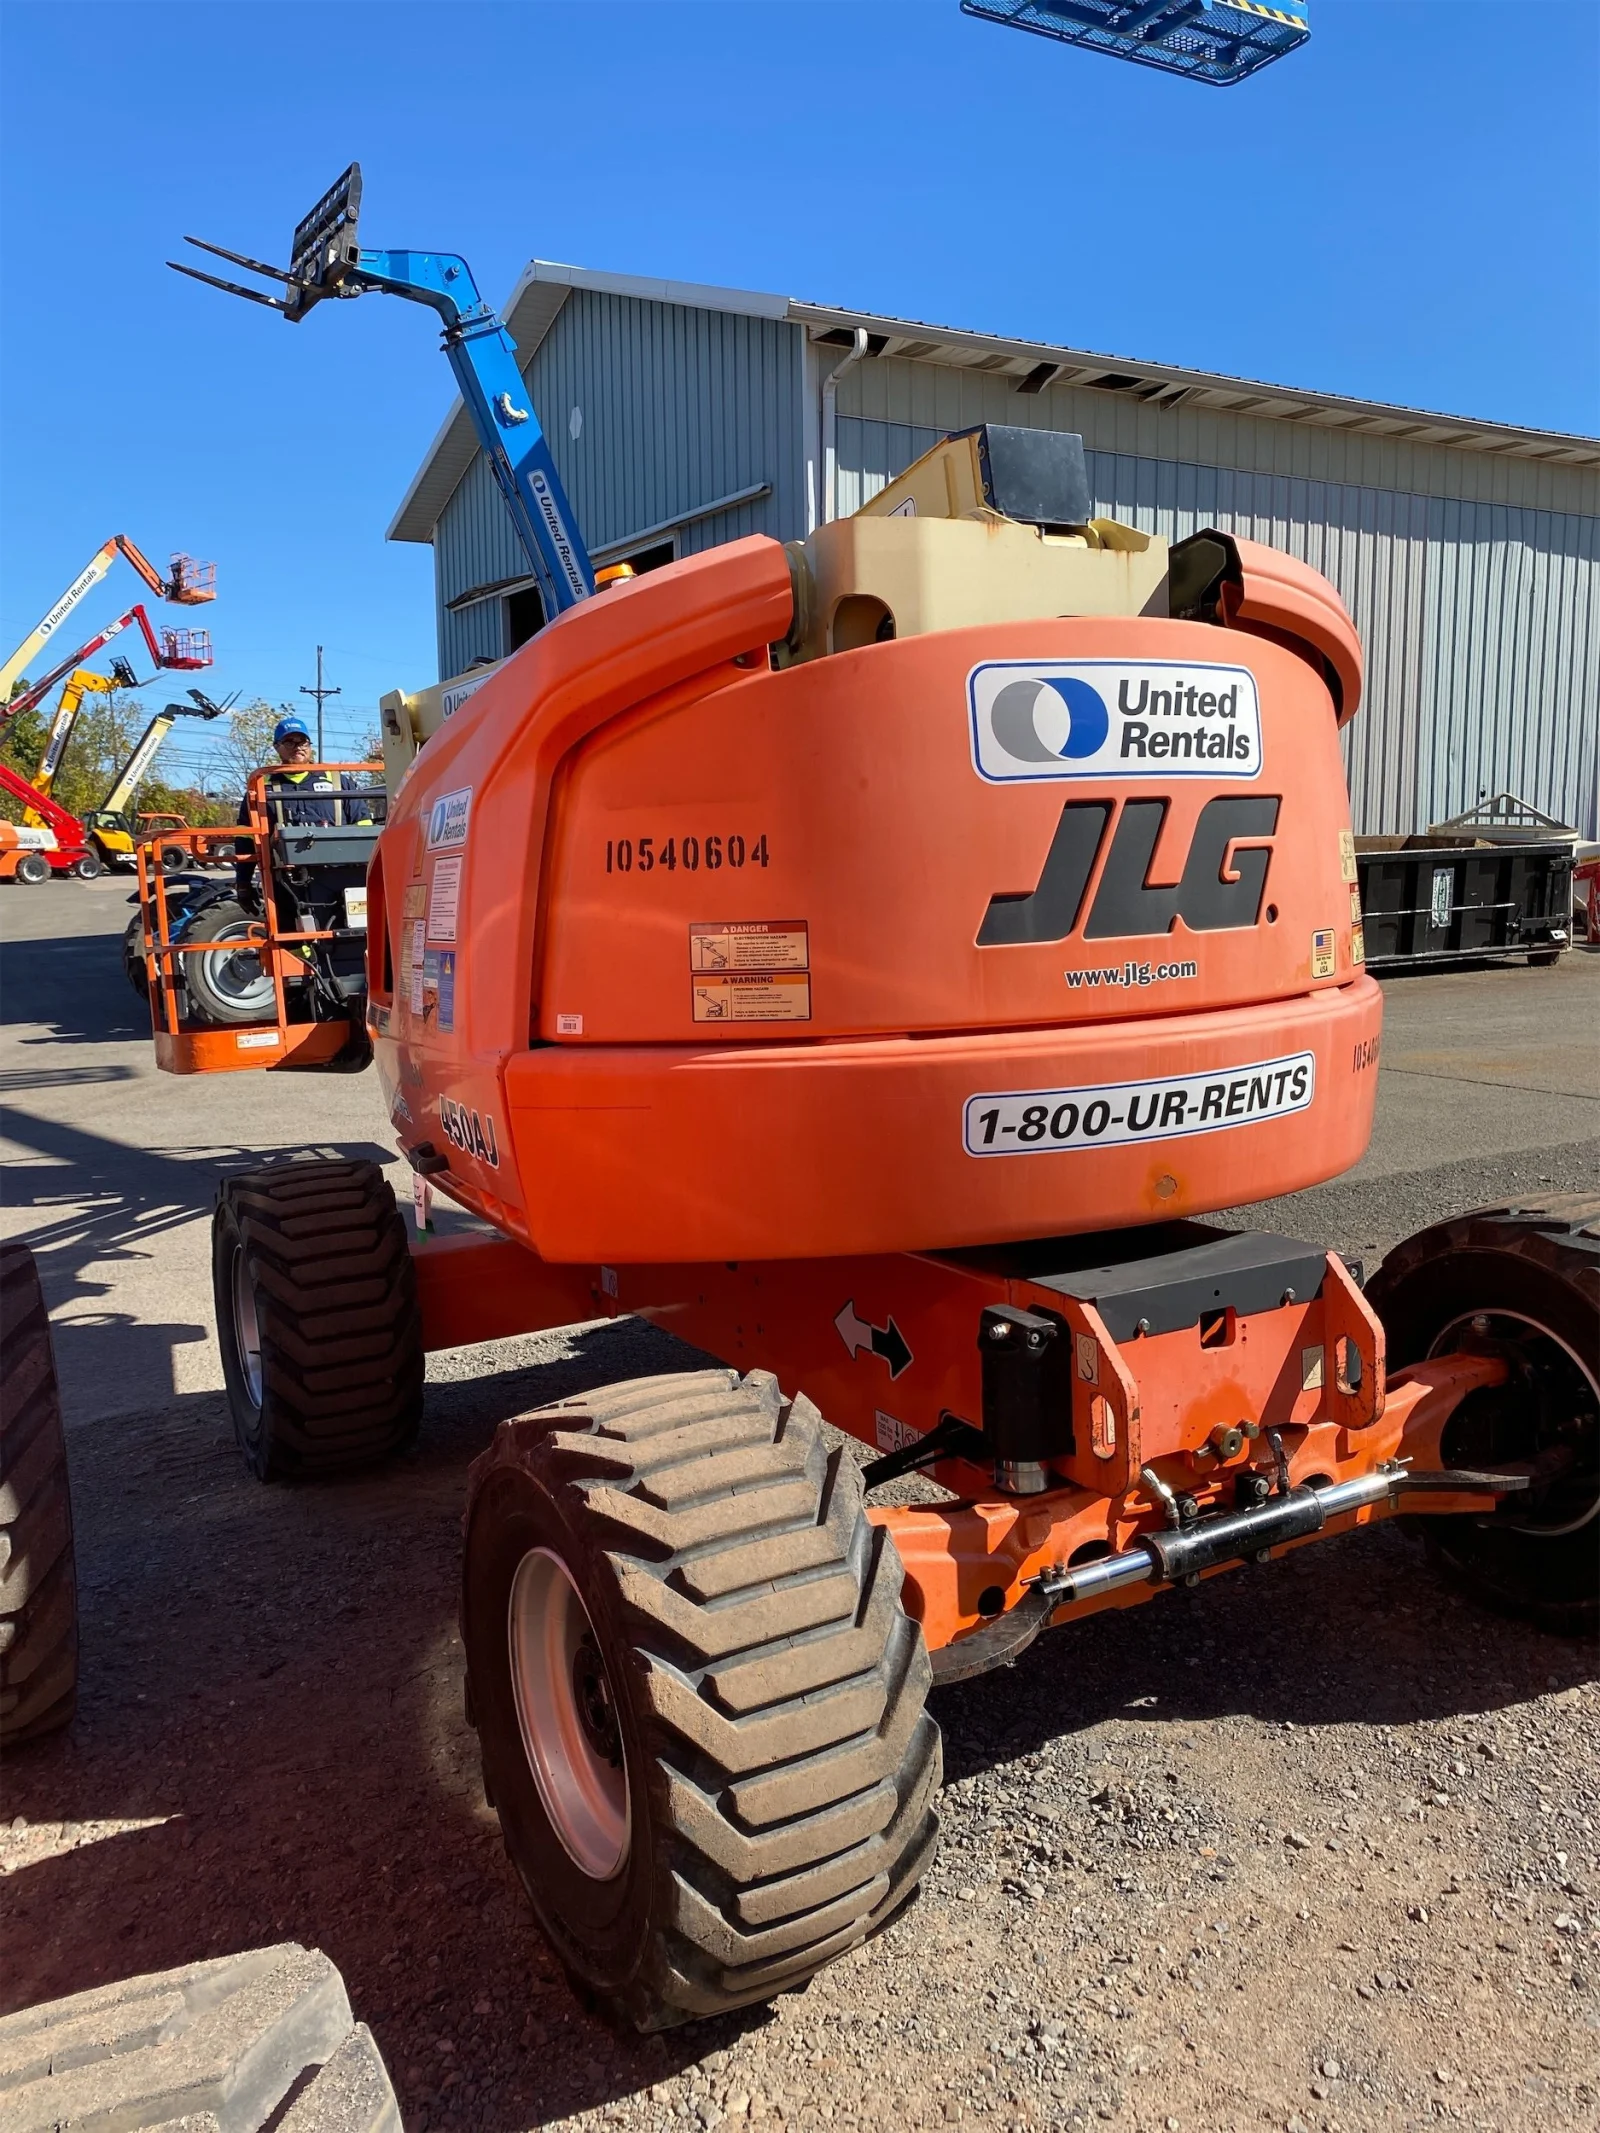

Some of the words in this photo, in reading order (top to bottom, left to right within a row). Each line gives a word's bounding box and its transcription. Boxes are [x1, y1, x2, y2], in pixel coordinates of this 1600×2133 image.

[540, 496, 566, 542] United
[559, 545, 585, 595] Rentals
[49, 596, 74, 625] United
[70, 569, 97, 599] Rentals
[1118, 680, 1237, 719] United
[1120, 721, 1250, 760] Rentals
[446, 795, 469, 820] United
[443, 818, 467, 841] Rentals
[606, 834, 770, 874] 10540604
[977, 795, 1281, 946] JLG
[730, 925, 769, 933] DANGER
[730, 976, 774, 984] WARNING
[1065, 962, 1197, 988] www.jlg.com
[977, 1064, 1308, 1145] 1-800-UR-RENTS
[440, 1093, 500, 1170] 450AJ
